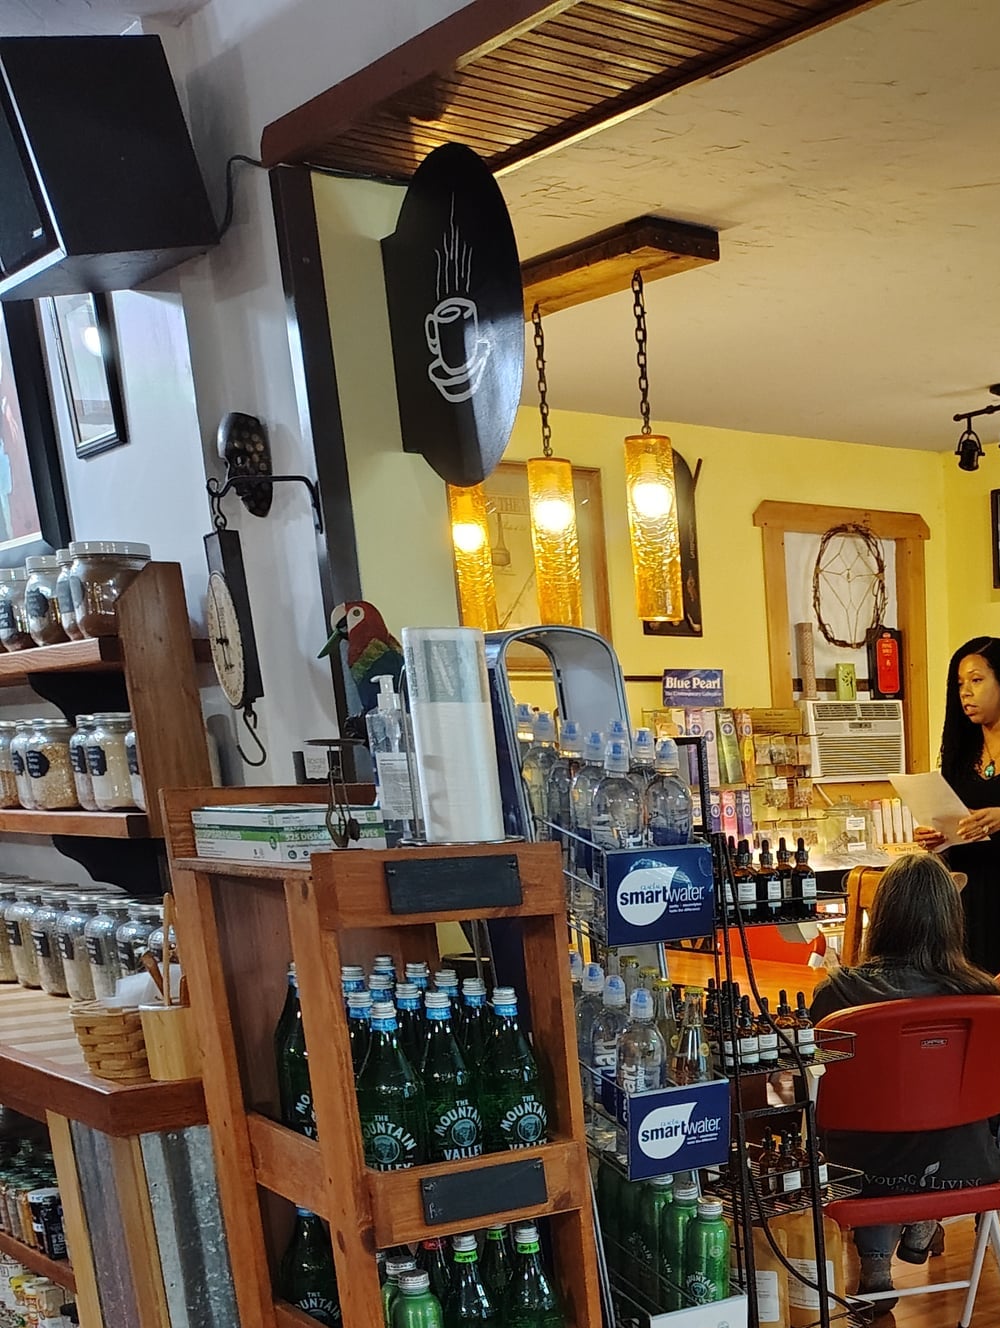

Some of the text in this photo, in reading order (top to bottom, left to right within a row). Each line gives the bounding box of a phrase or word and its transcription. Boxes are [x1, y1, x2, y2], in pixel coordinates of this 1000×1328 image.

[665, 676, 721, 689] Blue Pearl
[620, 885, 705, 905] smartwater
[363, 1121, 417, 1151] OUNTAIN
[641, 1117, 721, 1142] smartwater
